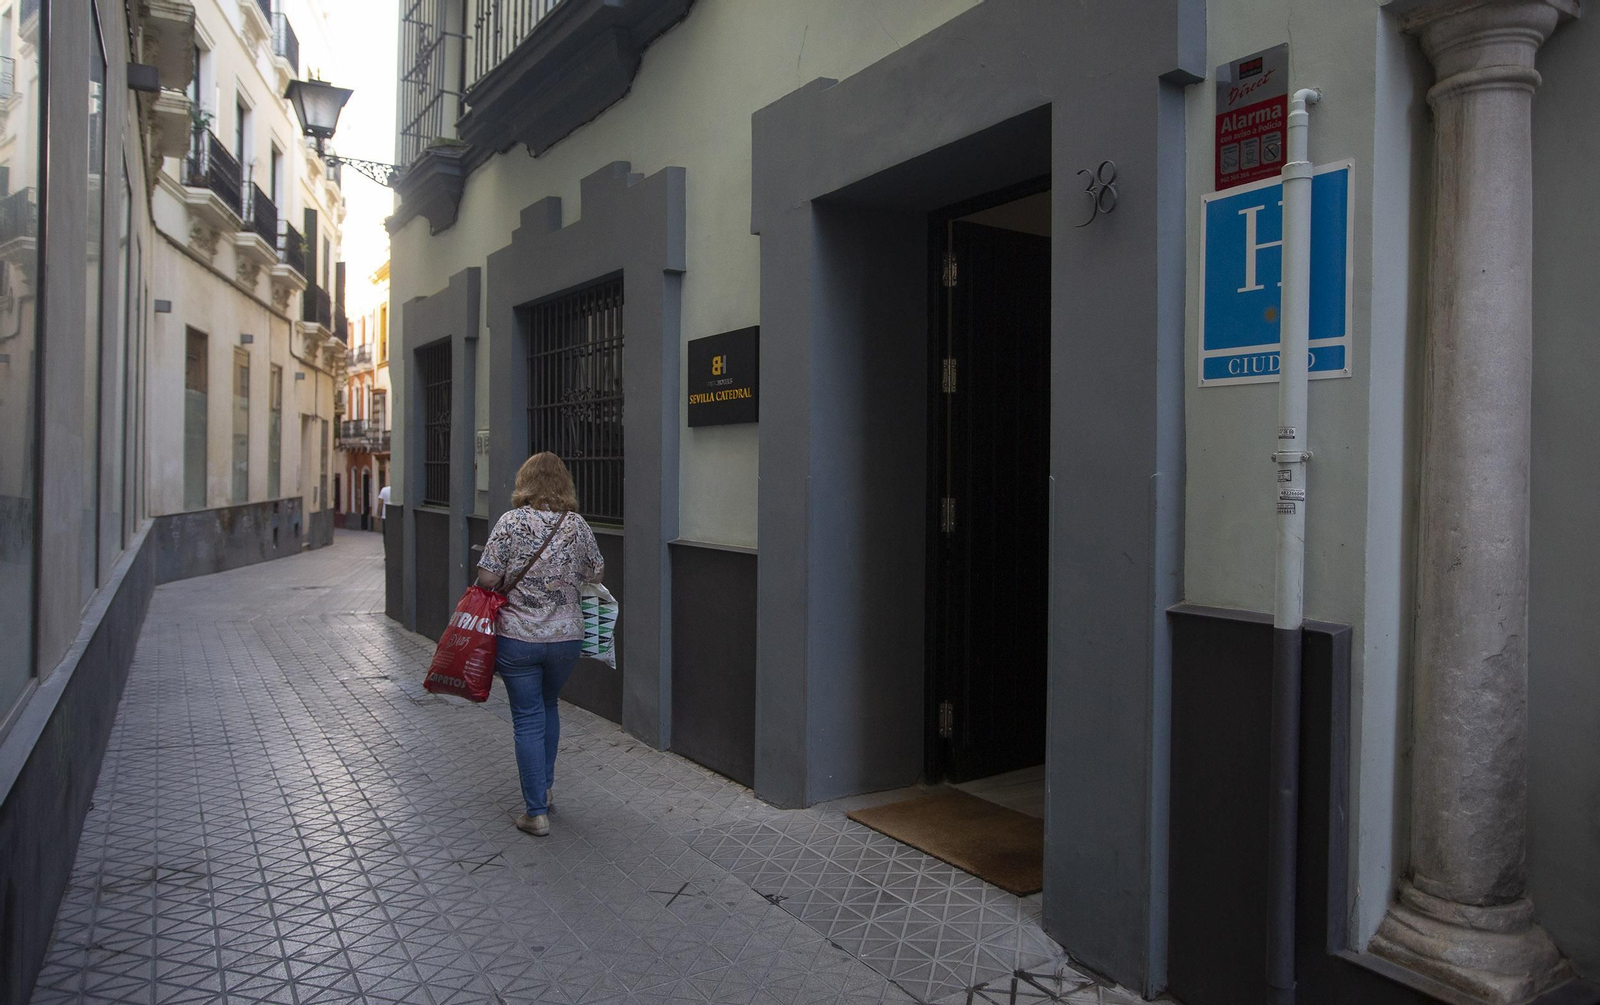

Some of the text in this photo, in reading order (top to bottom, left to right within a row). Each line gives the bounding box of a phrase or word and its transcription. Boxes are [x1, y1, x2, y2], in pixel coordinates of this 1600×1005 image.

[1220, 104, 1282, 134] Alarma
[1220, 134, 1233, 144] con
[1233, 129, 1251, 140] aviso
[1074, 159, 1118, 228] 38
[1228, 352, 1316, 375] CIUDD
[689, 387, 752, 405] SEVILLA CATEDRAL
